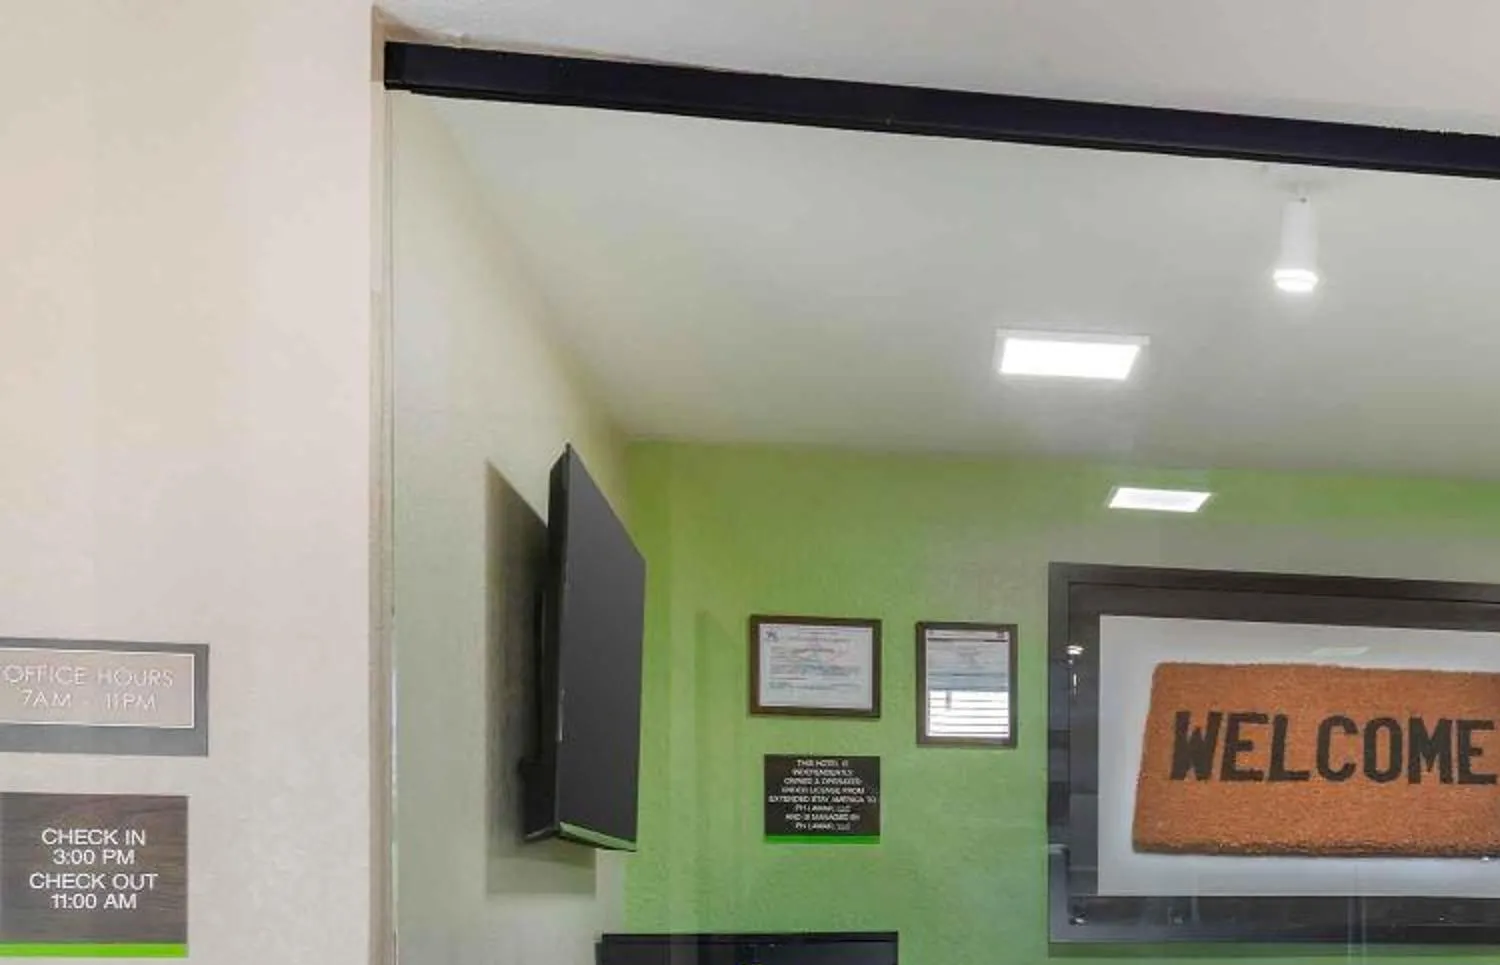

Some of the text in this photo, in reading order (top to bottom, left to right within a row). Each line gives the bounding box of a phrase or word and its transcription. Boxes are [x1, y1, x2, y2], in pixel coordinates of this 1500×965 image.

[3, 663, 174, 688] OFFICE HOURS
[20, 689, 73, 708] 7AM
[1168, 709, 1499, 786] WELCOME
[41, 828, 146, 846] CHECK IN
[52, 848, 135, 865] 3:00 PM
[29, 873, 158, 890] CHECK OUT
[51, 893, 137, 909] 11:00 AM
